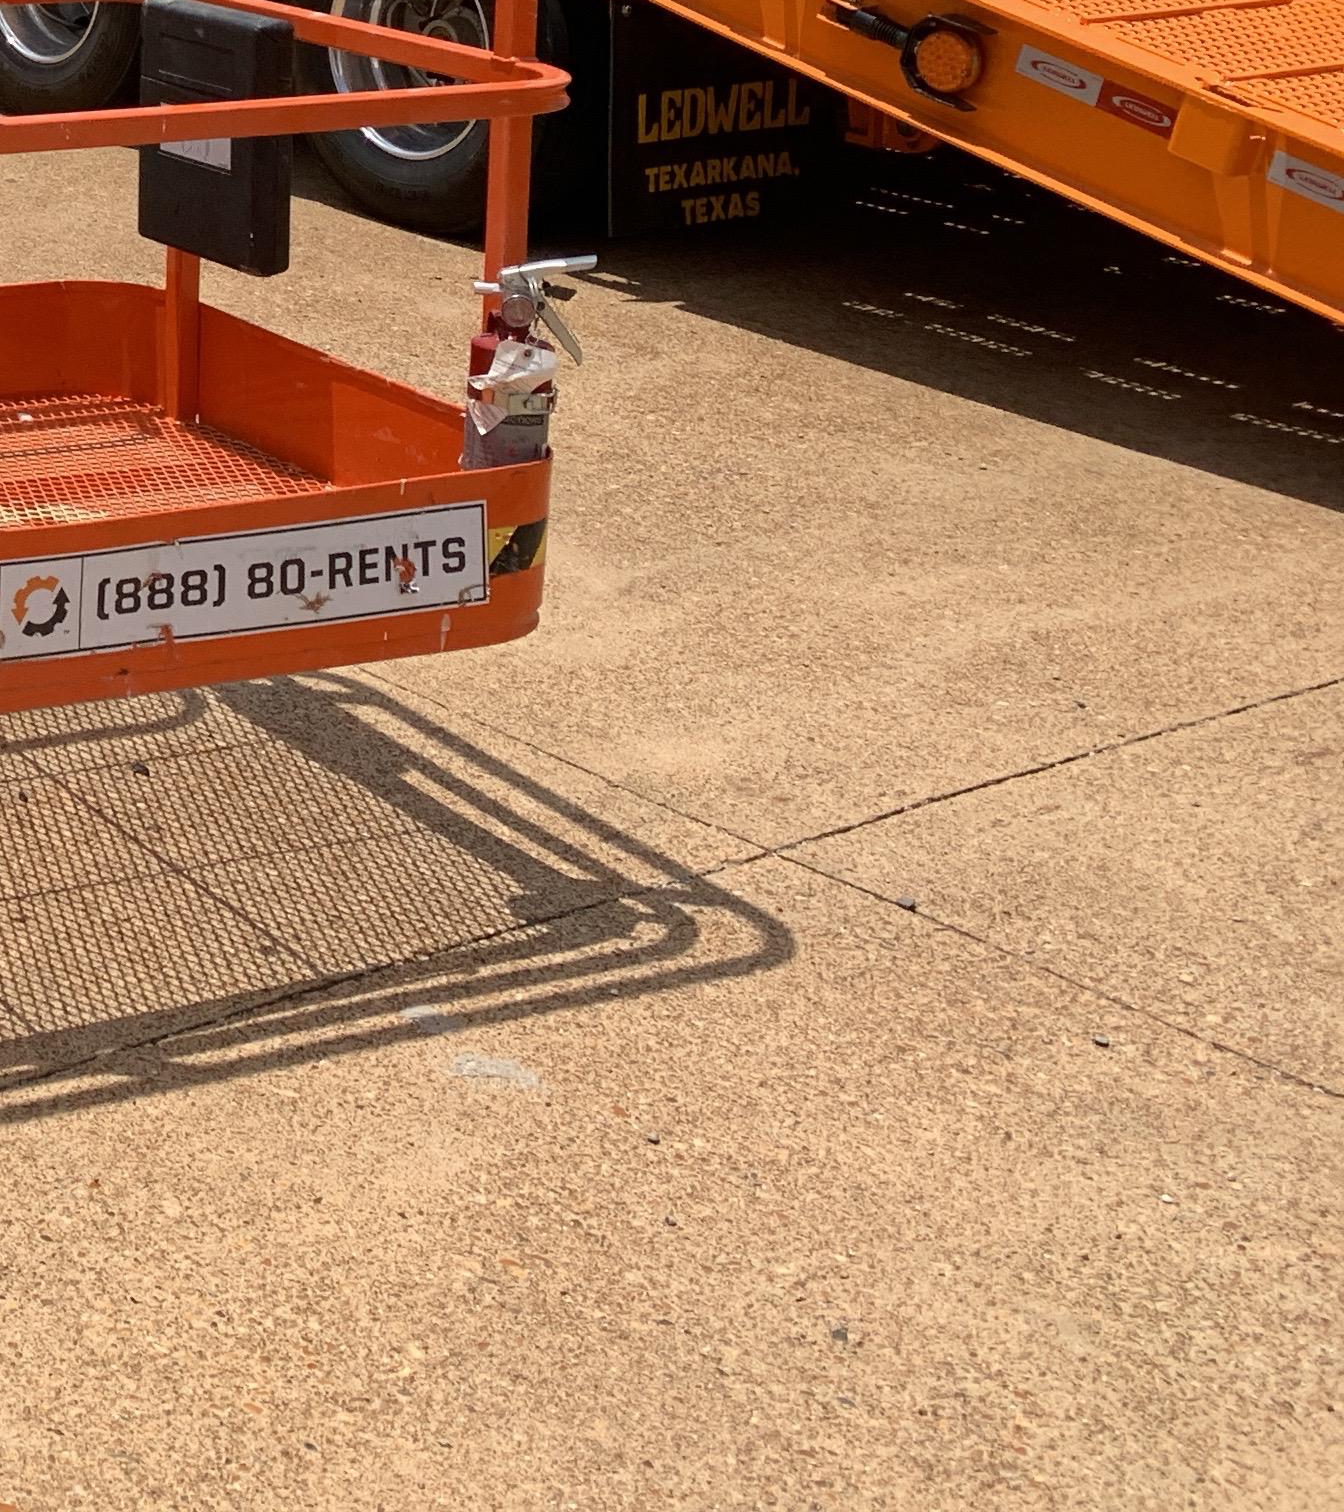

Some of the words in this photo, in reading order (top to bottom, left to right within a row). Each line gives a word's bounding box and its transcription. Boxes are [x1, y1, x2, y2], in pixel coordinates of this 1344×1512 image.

[637, 77, 811, 144] LEDWELL
[644, 151, 801, 193] TEXARKANA,
[680, 191, 761, 226] TEXAS
[95, 563, 226, 620] (888)
[246, 536, 467, 600] 80-RENTS
